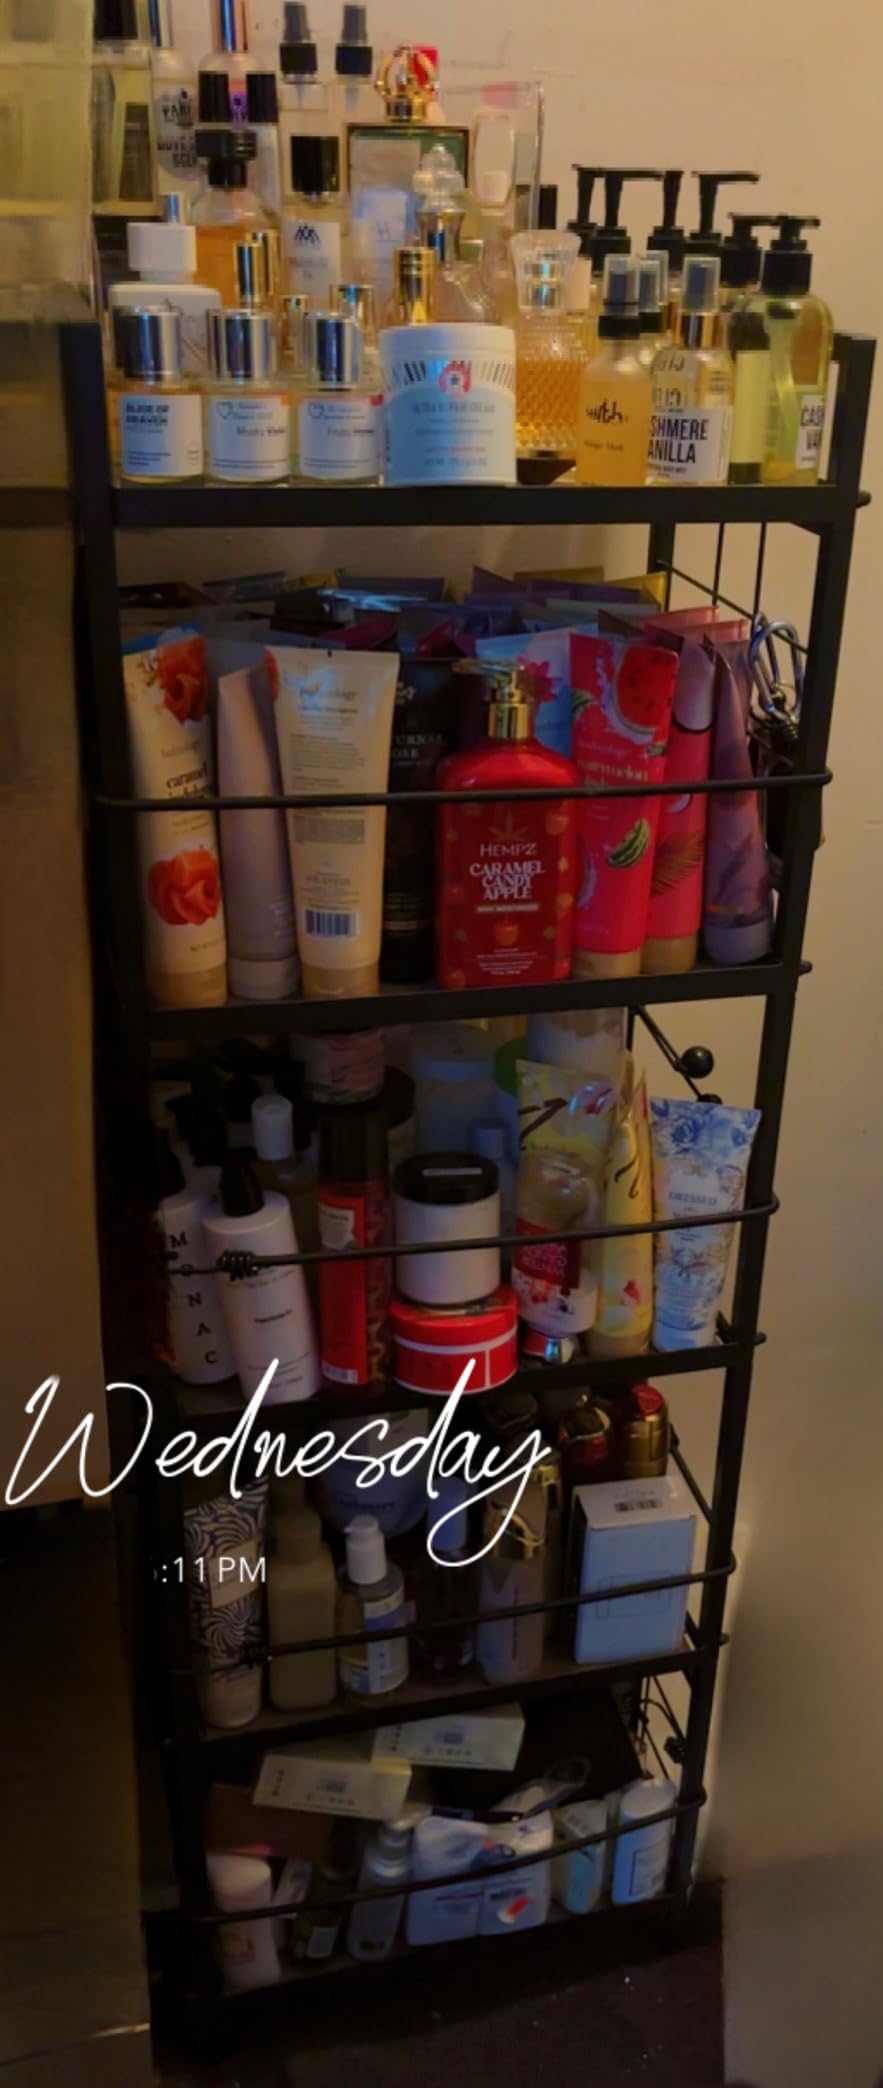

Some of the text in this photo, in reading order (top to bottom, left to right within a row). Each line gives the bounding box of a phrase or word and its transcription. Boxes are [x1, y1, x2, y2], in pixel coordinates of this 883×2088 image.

[649, 415, 709, 441] SHMERE
[647, 439, 696, 464] ANILLA
[479, 841, 537, 858] HEMPZ
[469, 860, 546, 879] CARAMEL
[481, 874, 534, 890] CANDY
[481, 885, 534, 901] APPLE
